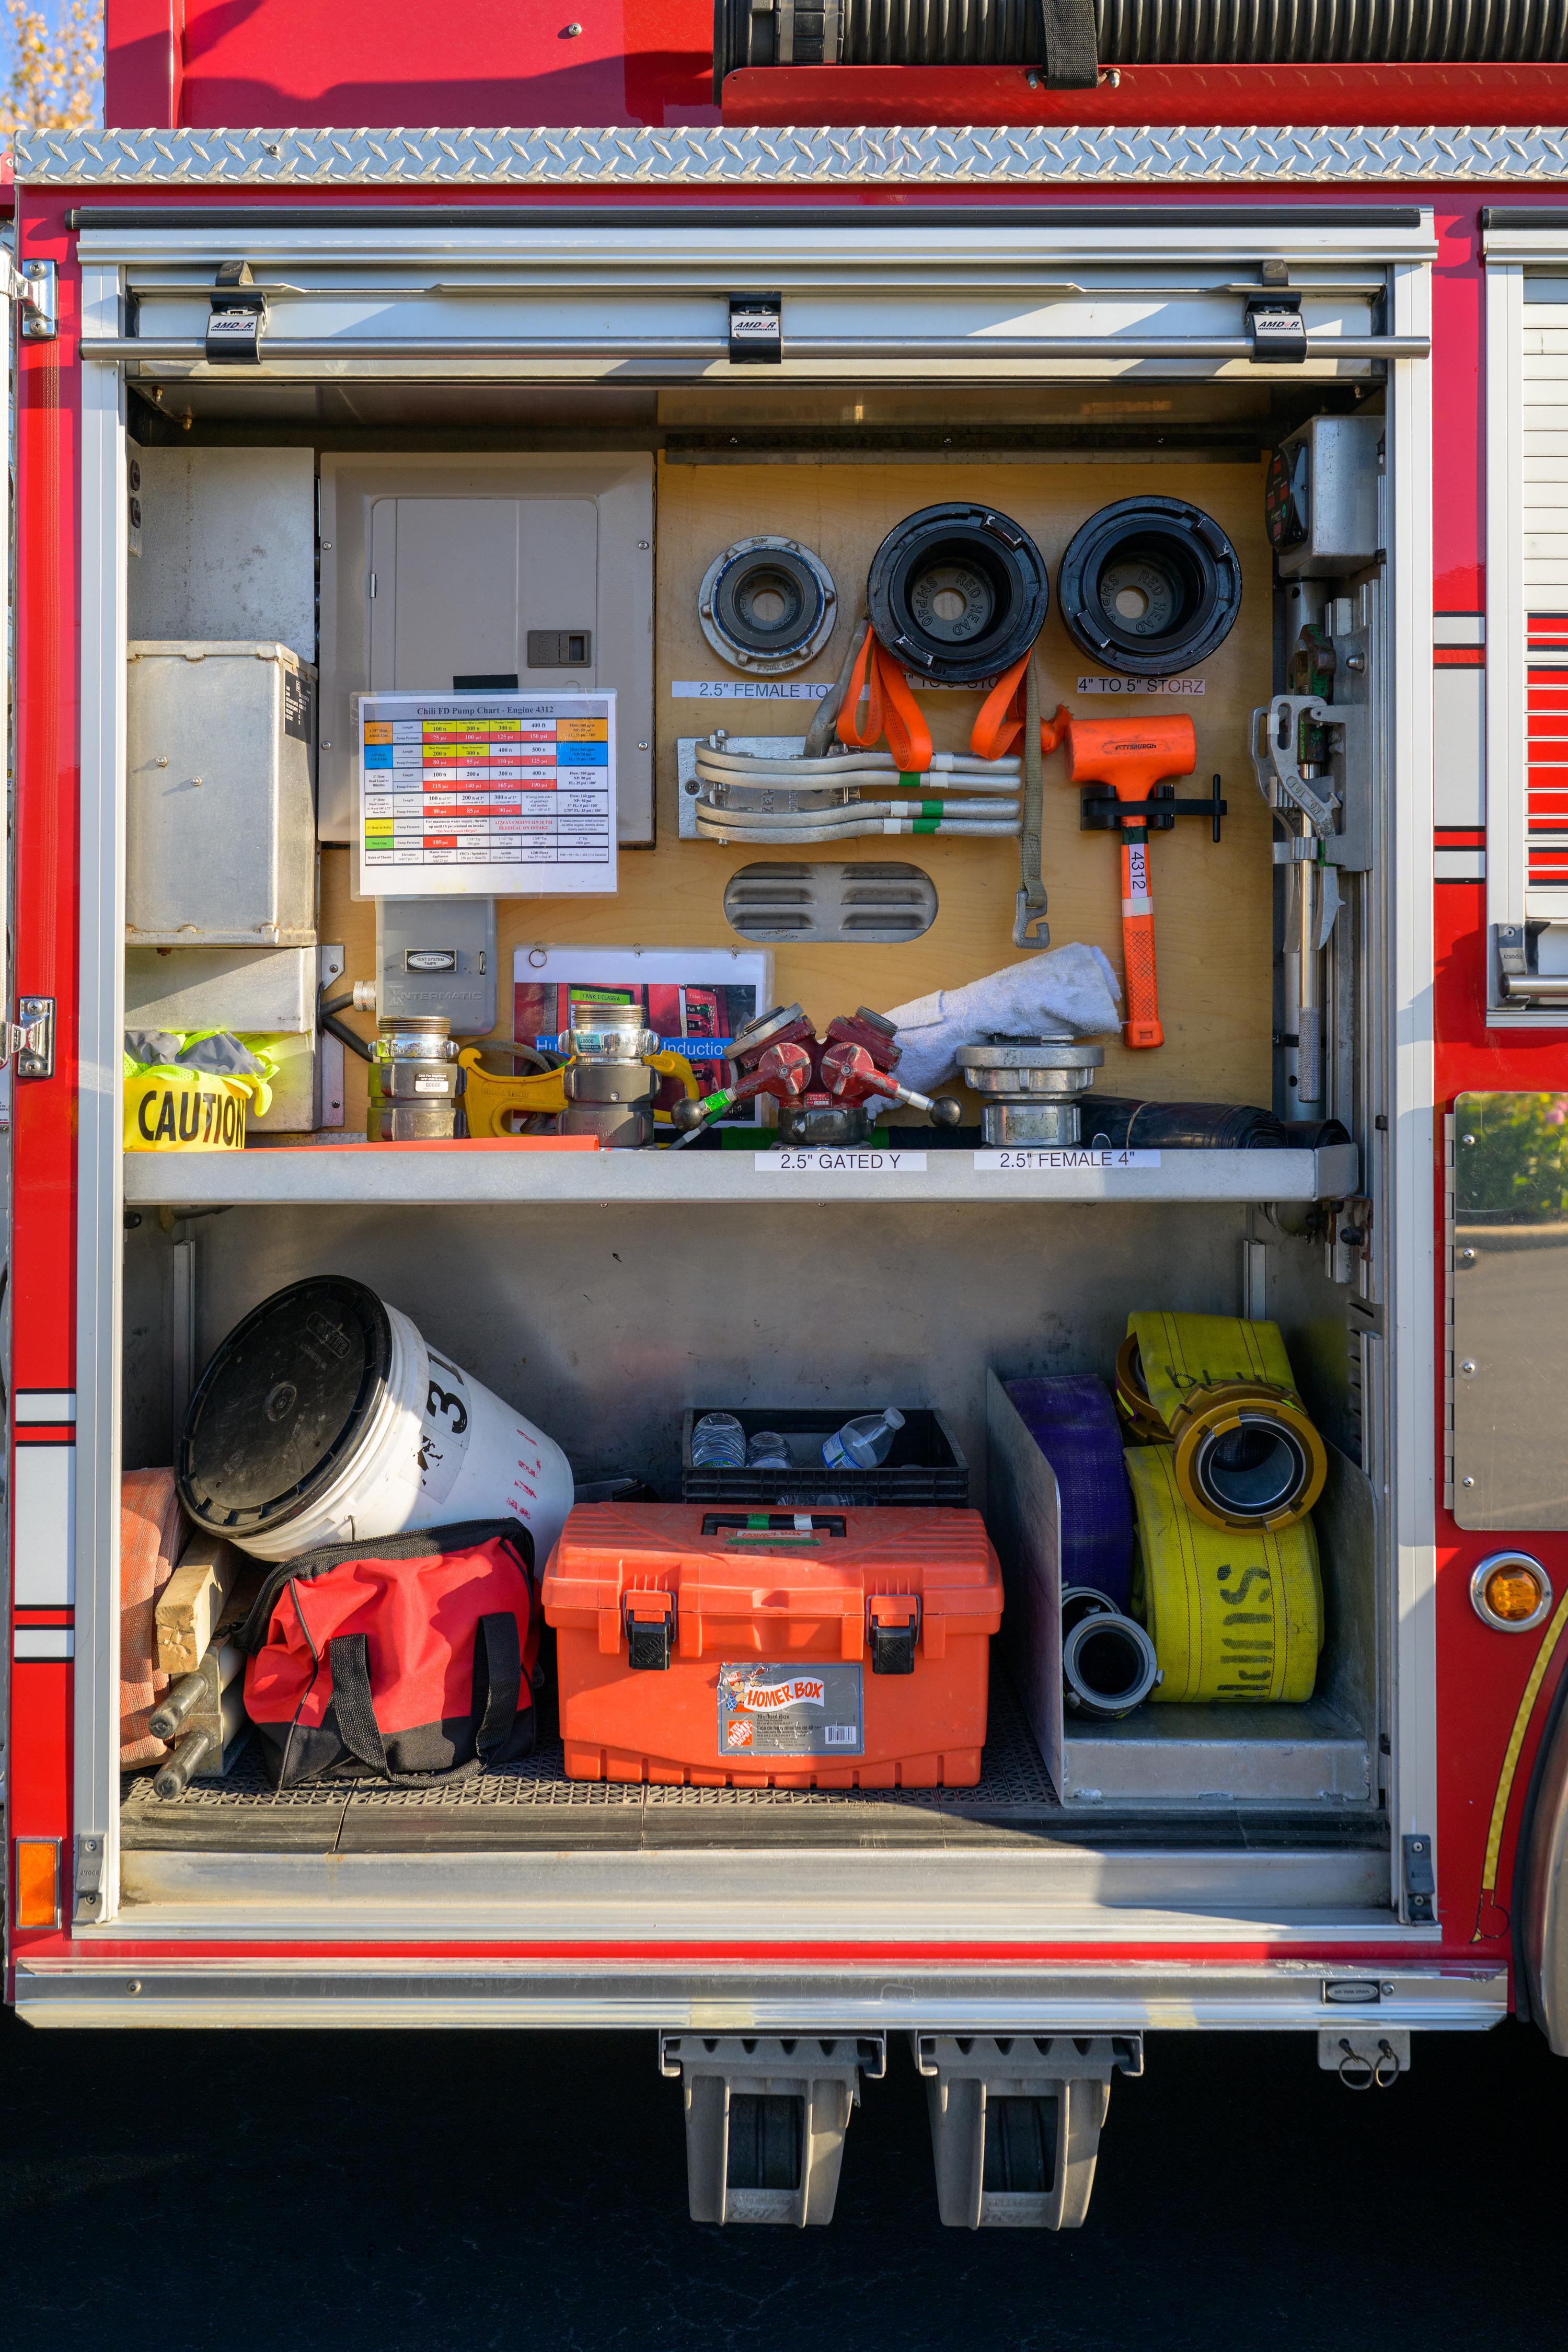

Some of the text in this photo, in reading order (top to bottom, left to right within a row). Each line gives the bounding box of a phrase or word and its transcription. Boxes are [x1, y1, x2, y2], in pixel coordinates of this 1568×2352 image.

[916, 576, 937, 627] SMP40
[952, 572, 983, 636] RED HEAD
[1135, 570, 1166, 633] RED HEAD
[699, 683, 828, 698] 2.5" FEMALE TO
[1078, 678, 1204, 693] 4" TO 5" STORZ
[1289, 782, 1306, 798] 101
[1131, 851, 1146, 890] 4312
[663, 1041, 727, 1056] Inductio
[138, 1090, 245, 1148] CAUTION
[781, 1154, 901, 1169] 2.5" GATED Y
[1000, 1151, 1135, 1168] 2.5" FEMALE 4"
[747, 1681, 824, 1708] HOMER BOX
[728, 1720, 753, 1746] HOME
[729, 1721, 741, 1733] THE
[736, 1730, 753, 1746] DEPOT
